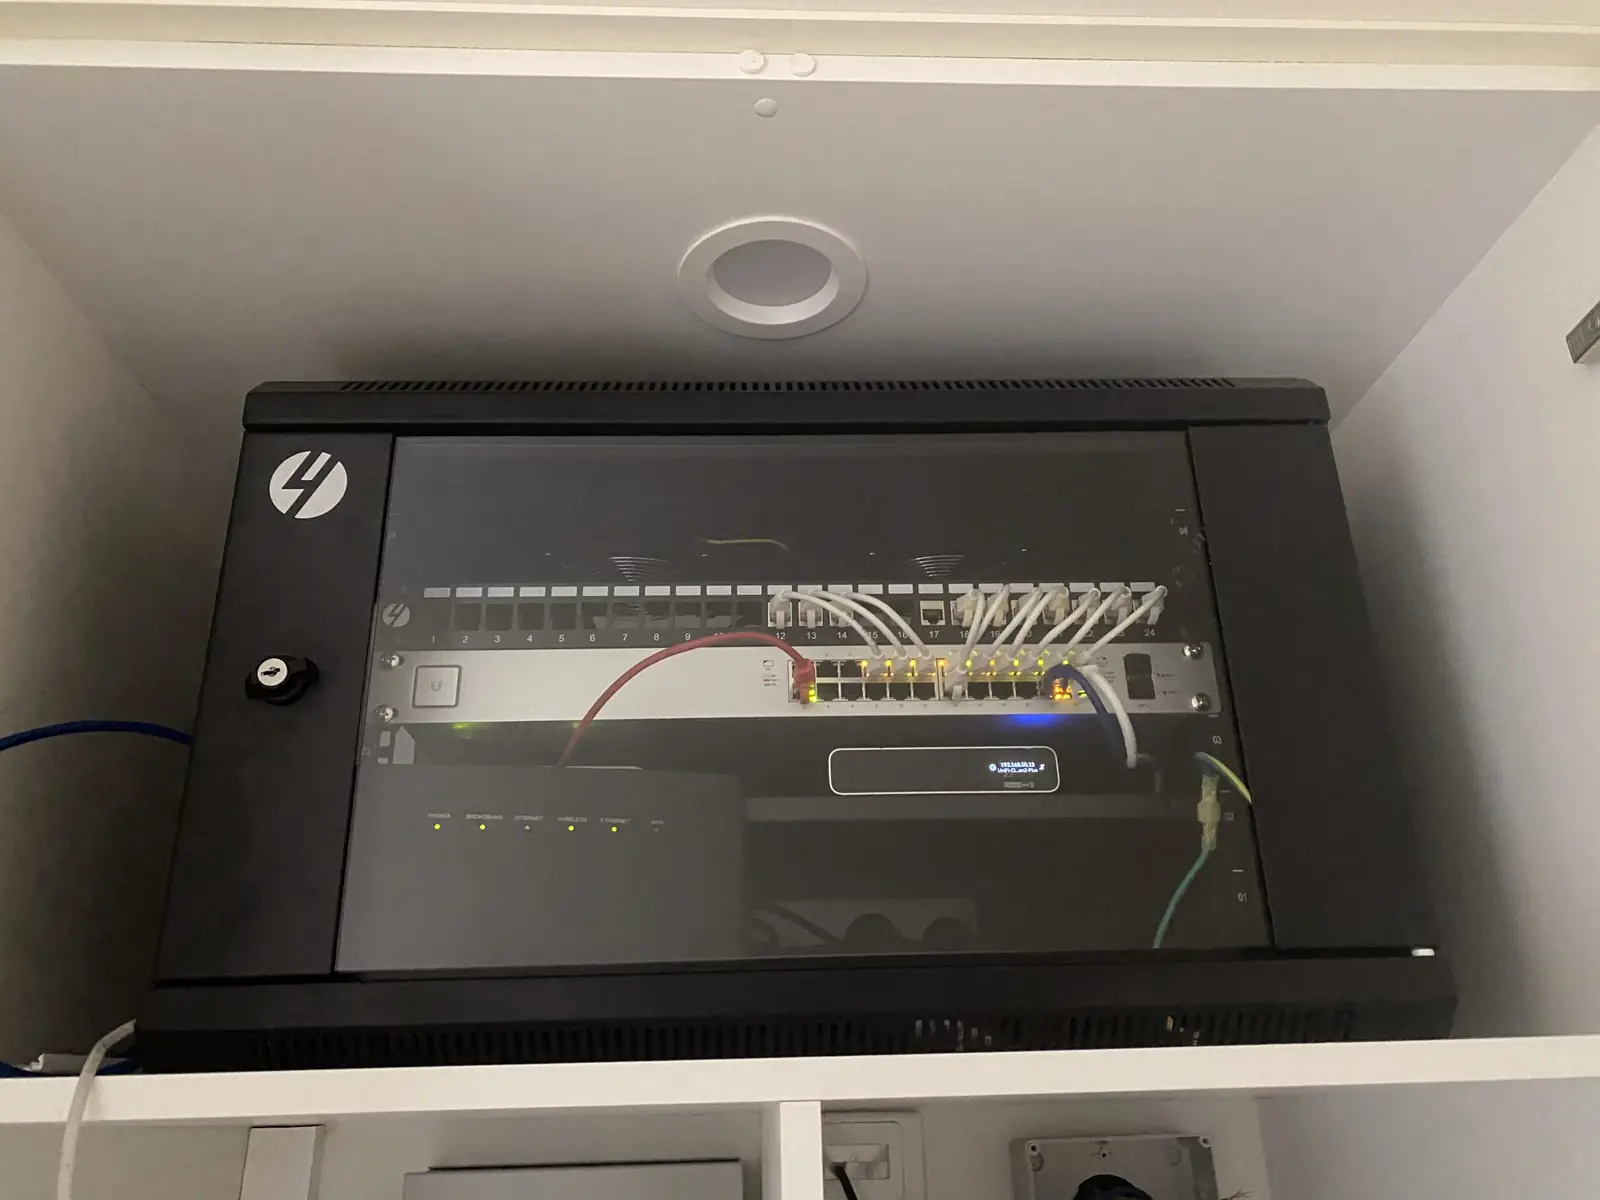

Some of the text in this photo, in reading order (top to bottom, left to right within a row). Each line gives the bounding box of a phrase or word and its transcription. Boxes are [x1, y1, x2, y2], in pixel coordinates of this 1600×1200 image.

[622, 633, 628, 641] 7
[653, 633, 660, 641] 8
[684, 633, 691, 641] 9
[775, 632, 786, 640] 12
[807, 632, 817, 640] 13
[991, 630, 1000, 638] 19
[1144, 629, 1155, 637] 24
[462, 636, 469, 644] 2
[494, 635, 501, 643] 3
[558, 634, 565, 642] 5
[589, 634, 596, 642] 6
[1213, 735, 1222, 744] 03
[1238, 892, 1247, 901] 01
